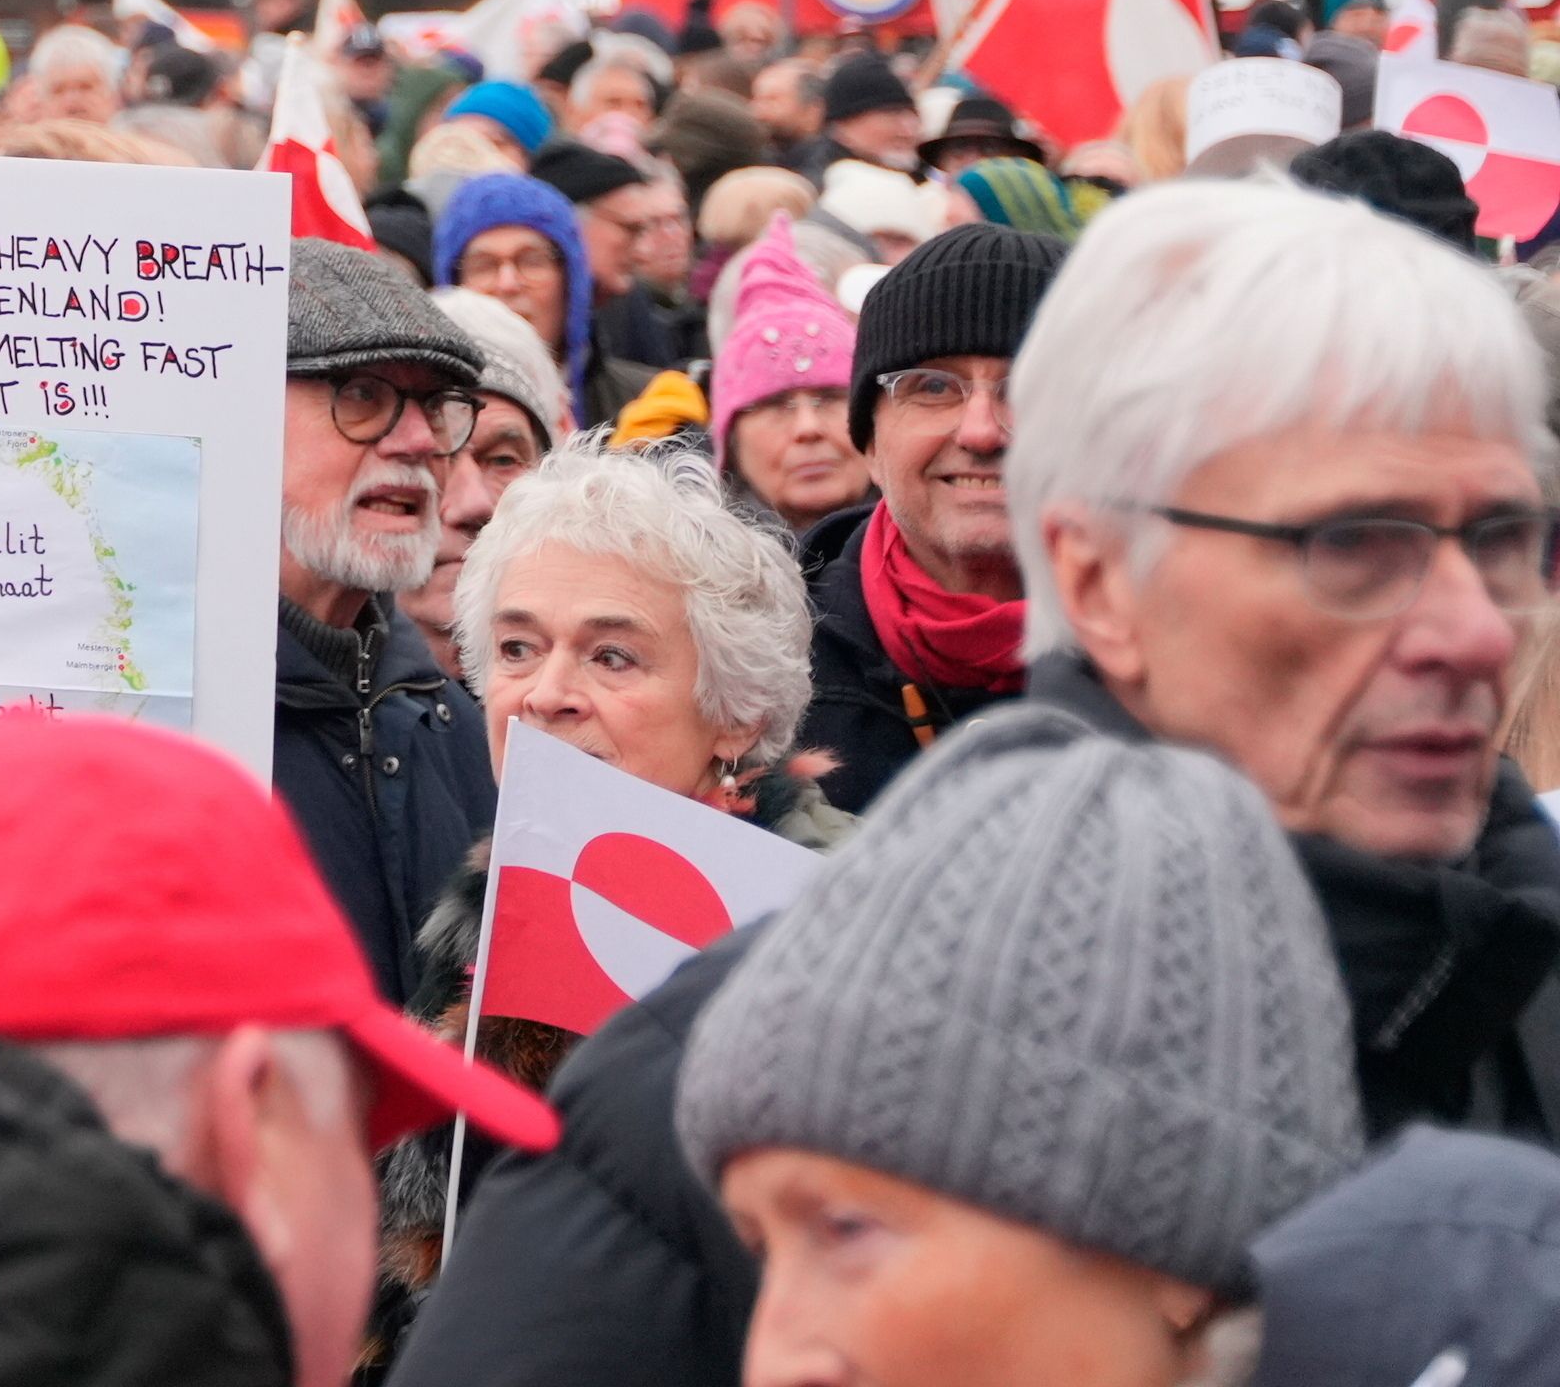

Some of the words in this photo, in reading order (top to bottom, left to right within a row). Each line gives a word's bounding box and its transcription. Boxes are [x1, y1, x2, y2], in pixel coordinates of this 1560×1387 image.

[137, 239, 284, 286] BREATH-
[141, 342, 233, 379] FAST
[7, 440, 28, 450] Fjord
